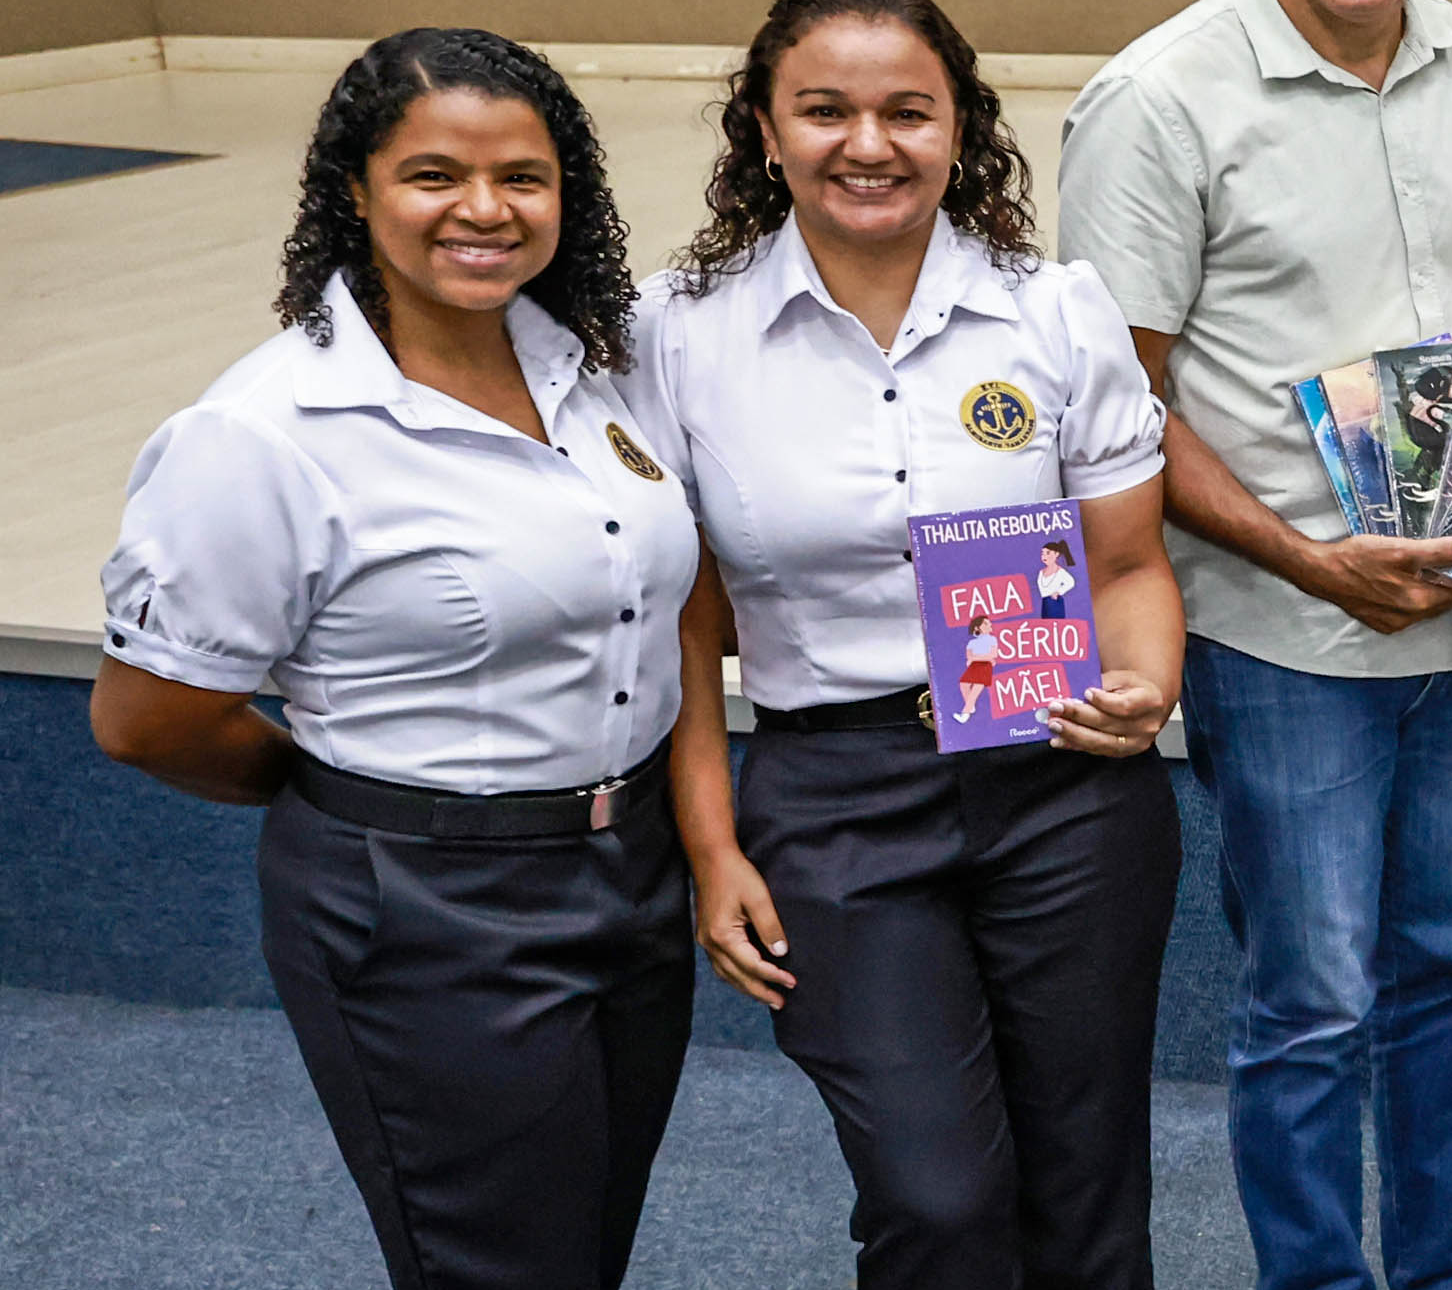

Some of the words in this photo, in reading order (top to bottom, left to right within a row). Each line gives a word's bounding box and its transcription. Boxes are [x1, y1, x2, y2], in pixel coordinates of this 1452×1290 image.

[921, 520, 986, 545] THALITA
[989, 509, 1073, 538] REBOUÇAS
[951, 581, 1025, 620] FALA
[997, 622, 1085, 660] SÉRIO,
[995, 669, 1063, 711] MÃE!
